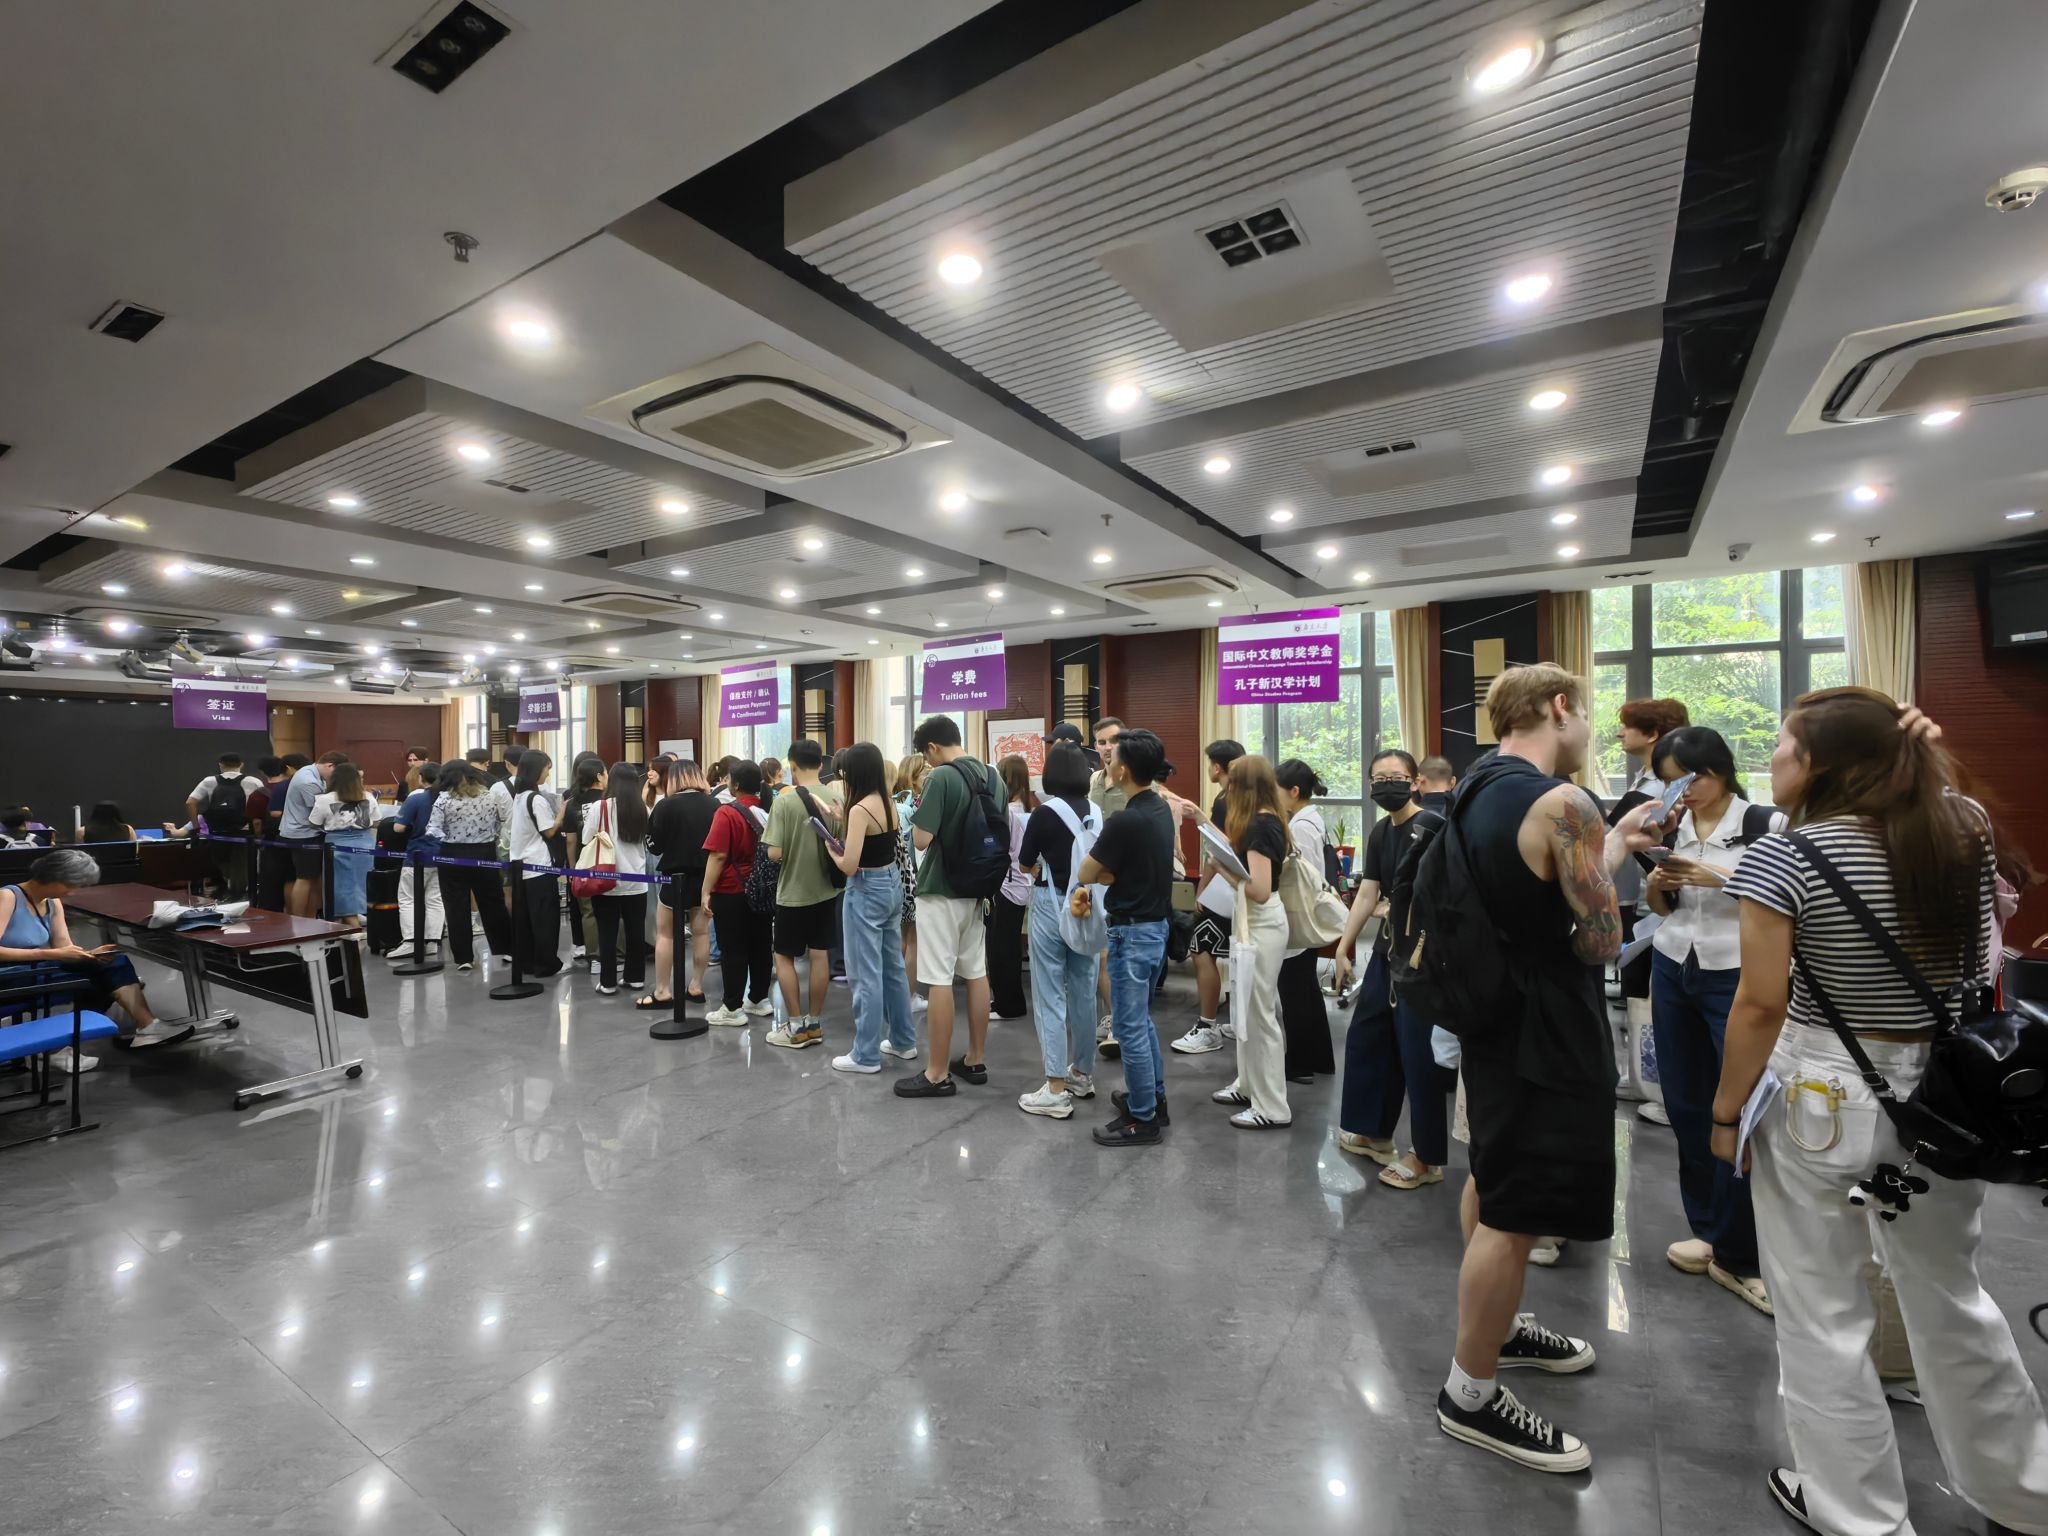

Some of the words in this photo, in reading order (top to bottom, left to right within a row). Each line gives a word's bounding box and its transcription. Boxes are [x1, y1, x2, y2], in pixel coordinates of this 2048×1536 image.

[1222, 644, 1332, 662] 国际中文教师奖学金
[952, 670, 976, 686] 学费
[1234, 675, 1320, 690] 孔子新汉学计划
[940, 692, 968, 700] Tuition
[970, 690, 988, 698] fees
[206, 698, 235, 710] 签证
[750, 700, 770, 708] Payment
